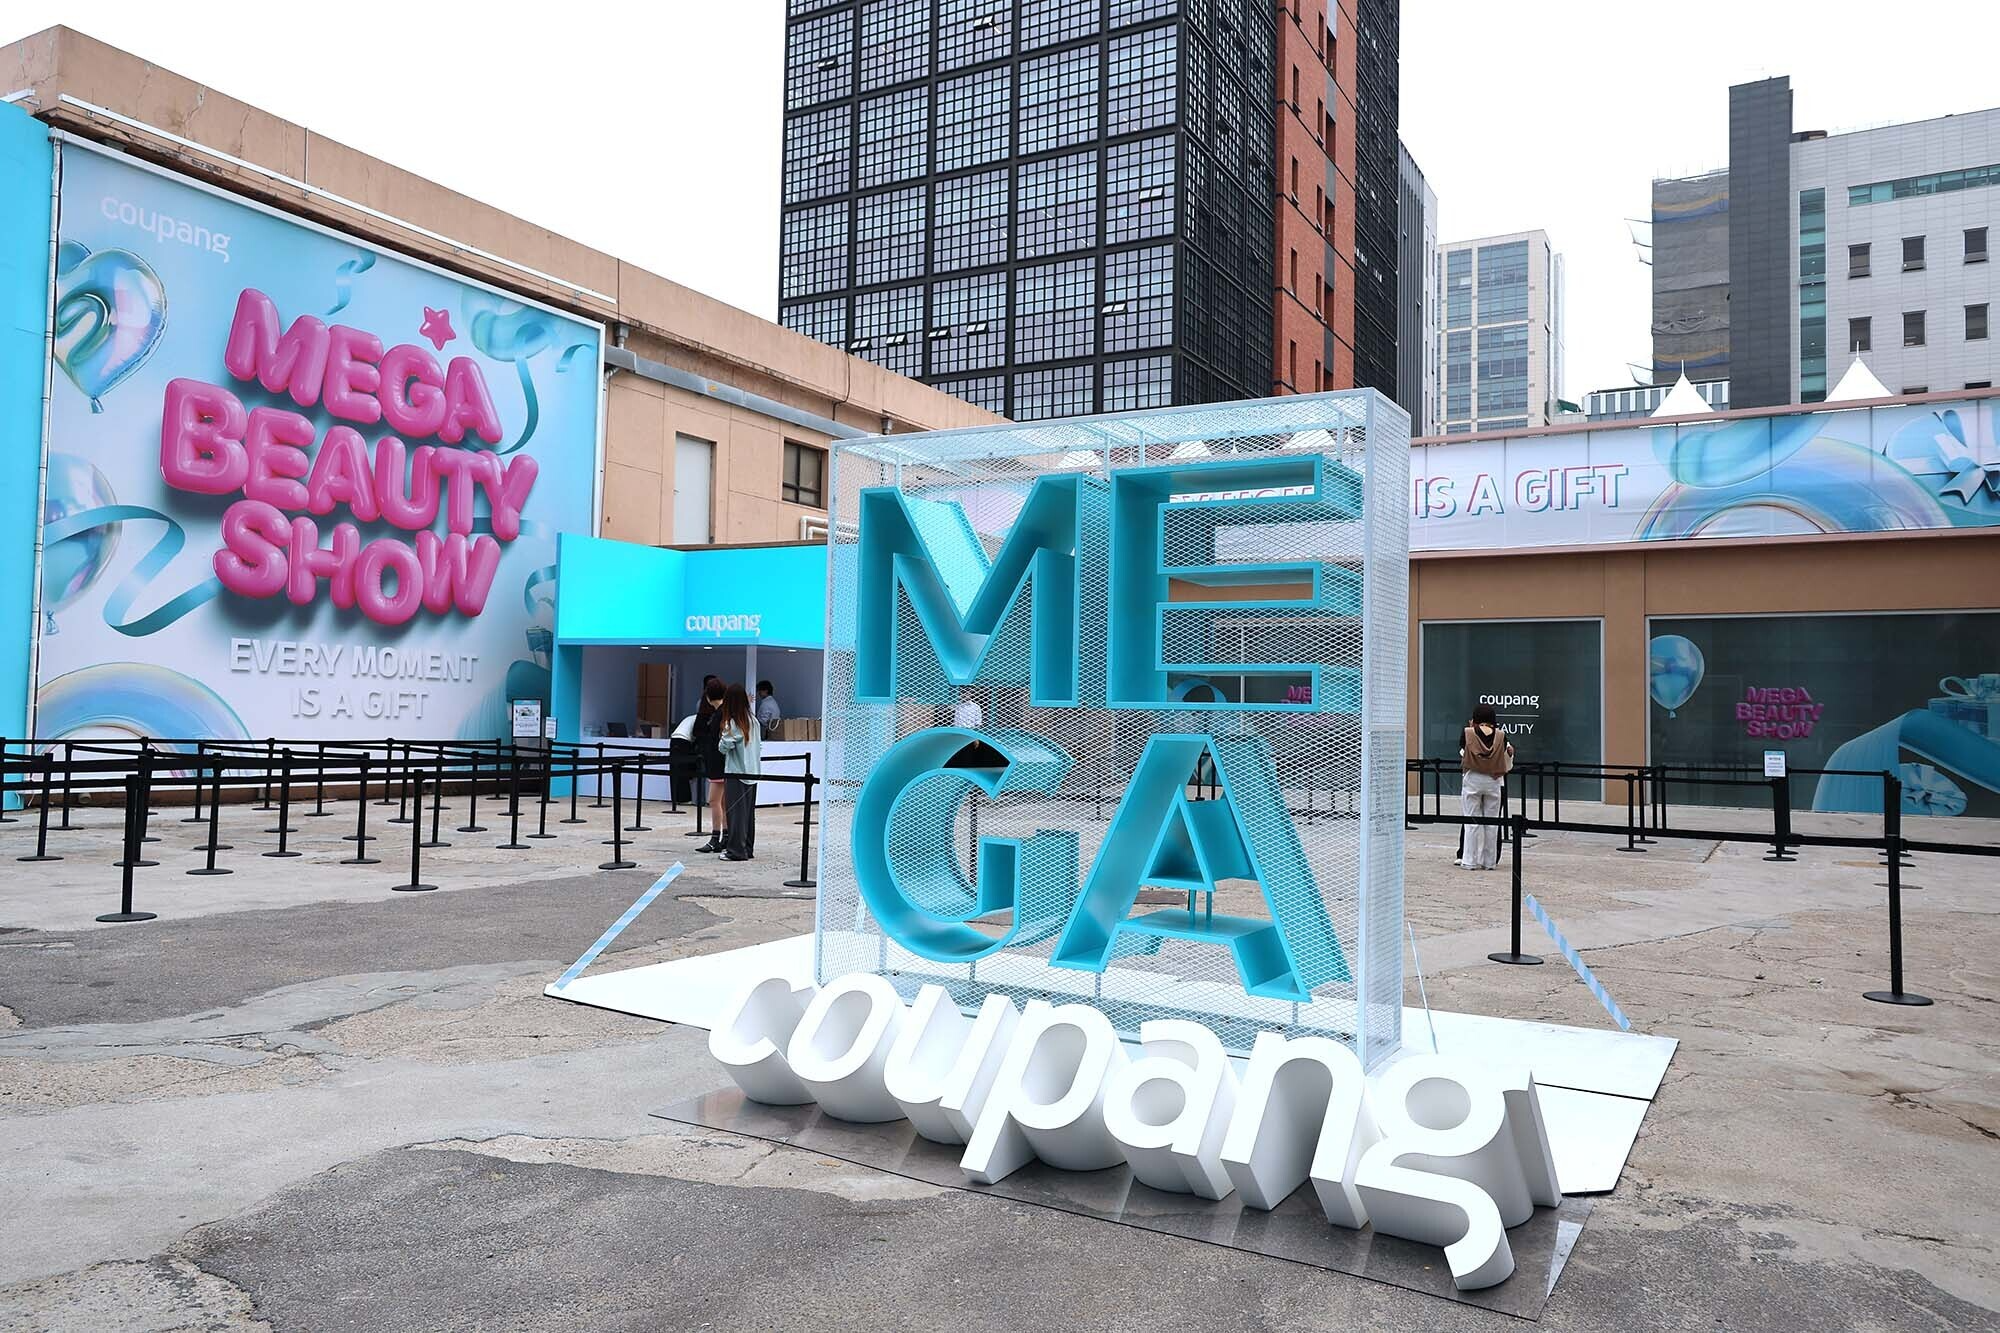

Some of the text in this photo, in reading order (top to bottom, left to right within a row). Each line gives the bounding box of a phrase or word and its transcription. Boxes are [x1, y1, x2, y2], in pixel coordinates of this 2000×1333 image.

[100, 196, 231, 263] coupang
[224, 288, 502, 444] MEGA
[160, 378, 539, 541] BEAUTY
[1414, 464, 1629, 519] IS A GIFT
[213, 500, 501, 626] SHOW
[855, 454, 1330, 712] ME
[685, 614, 761, 637] coupang
[230, 638, 479, 682] EVERY MOMENT
[291, 687, 429, 720] IS A GIFT
[1479, 694, 1540, 710] coupang
[1736, 702, 1824, 722] BEAUTY
[1745, 686, 1813, 704] MEGA
[1747, 720, 1814, 740] SHOW
[851, 726, 1320, 1002] GA
[708, 972, 1550, 1290] coupang
